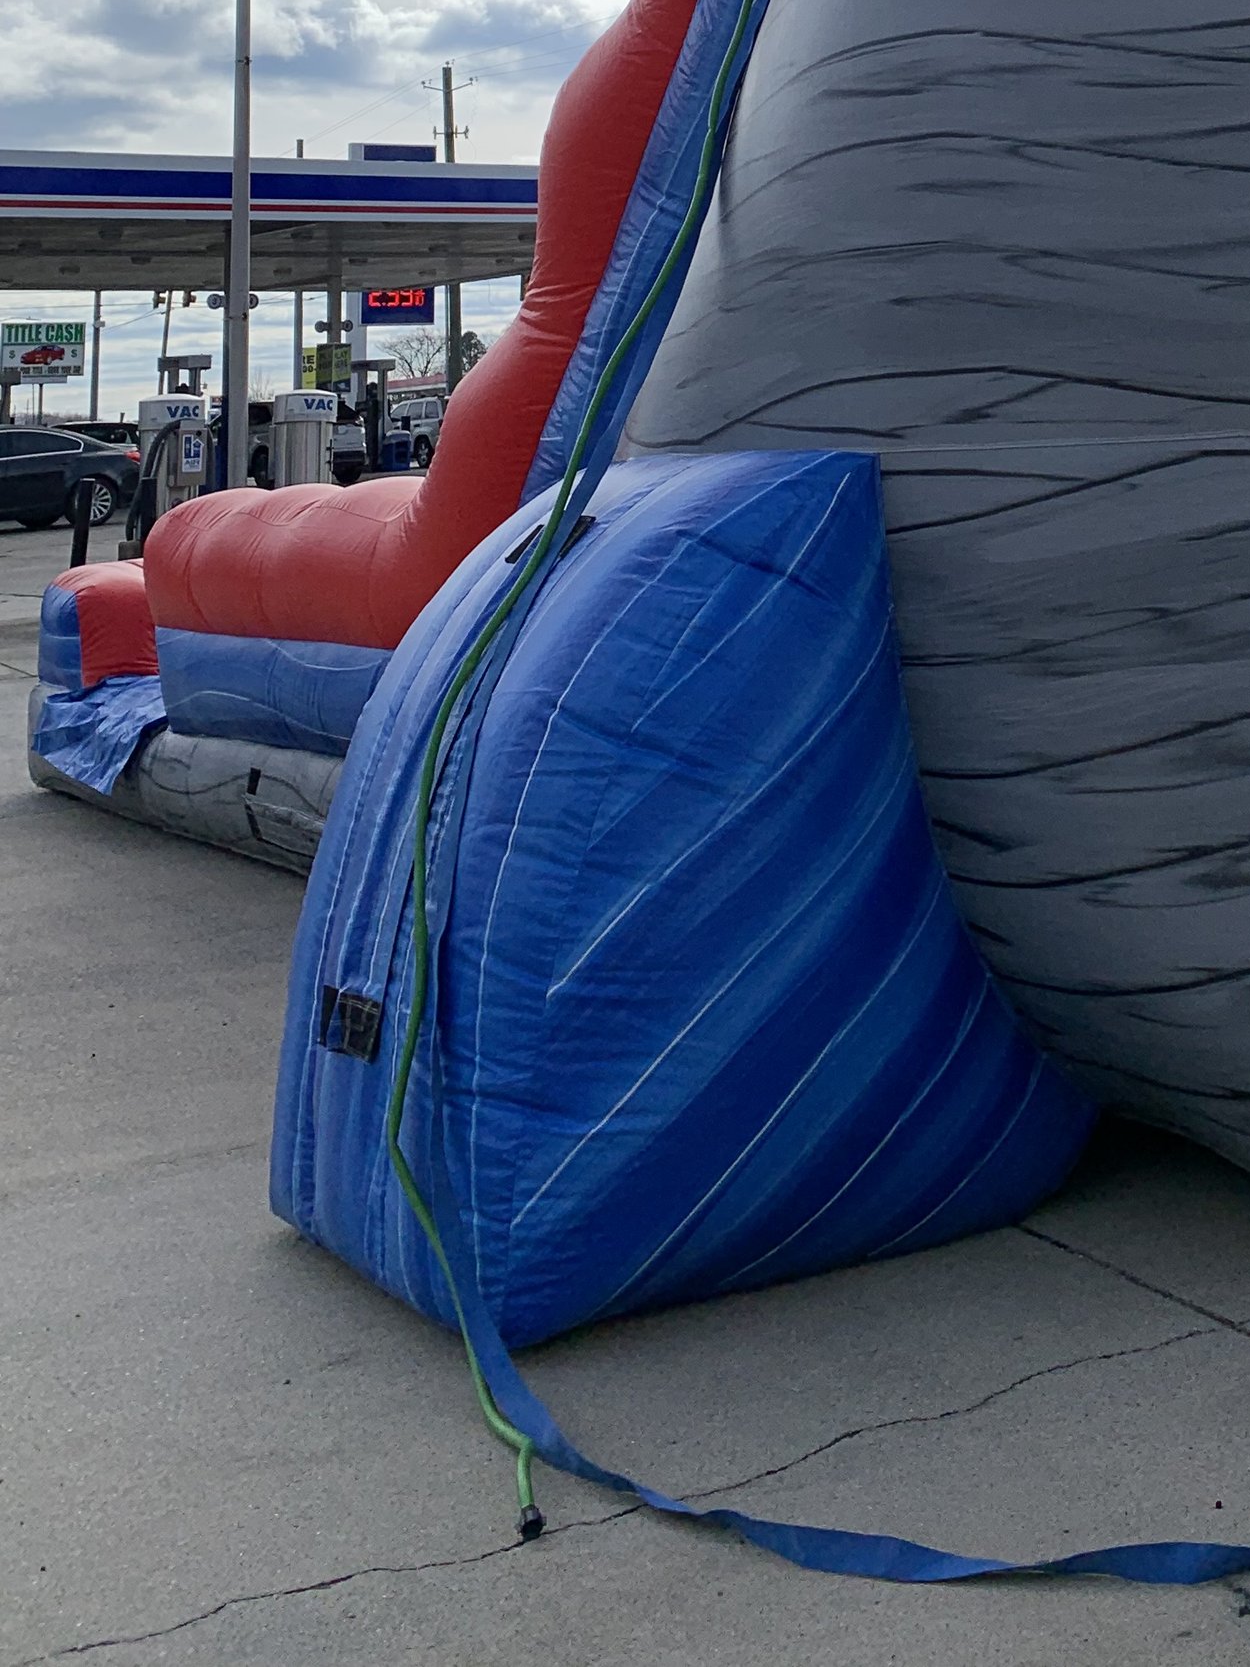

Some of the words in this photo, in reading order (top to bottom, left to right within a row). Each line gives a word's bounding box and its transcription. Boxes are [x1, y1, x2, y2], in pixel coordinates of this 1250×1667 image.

[6, 324, 42, 343] TITLE
[45, 324, 83, 343] CASH
[303, 398, 333, 411] VAC
[166, 405, 200, 419] VAC
